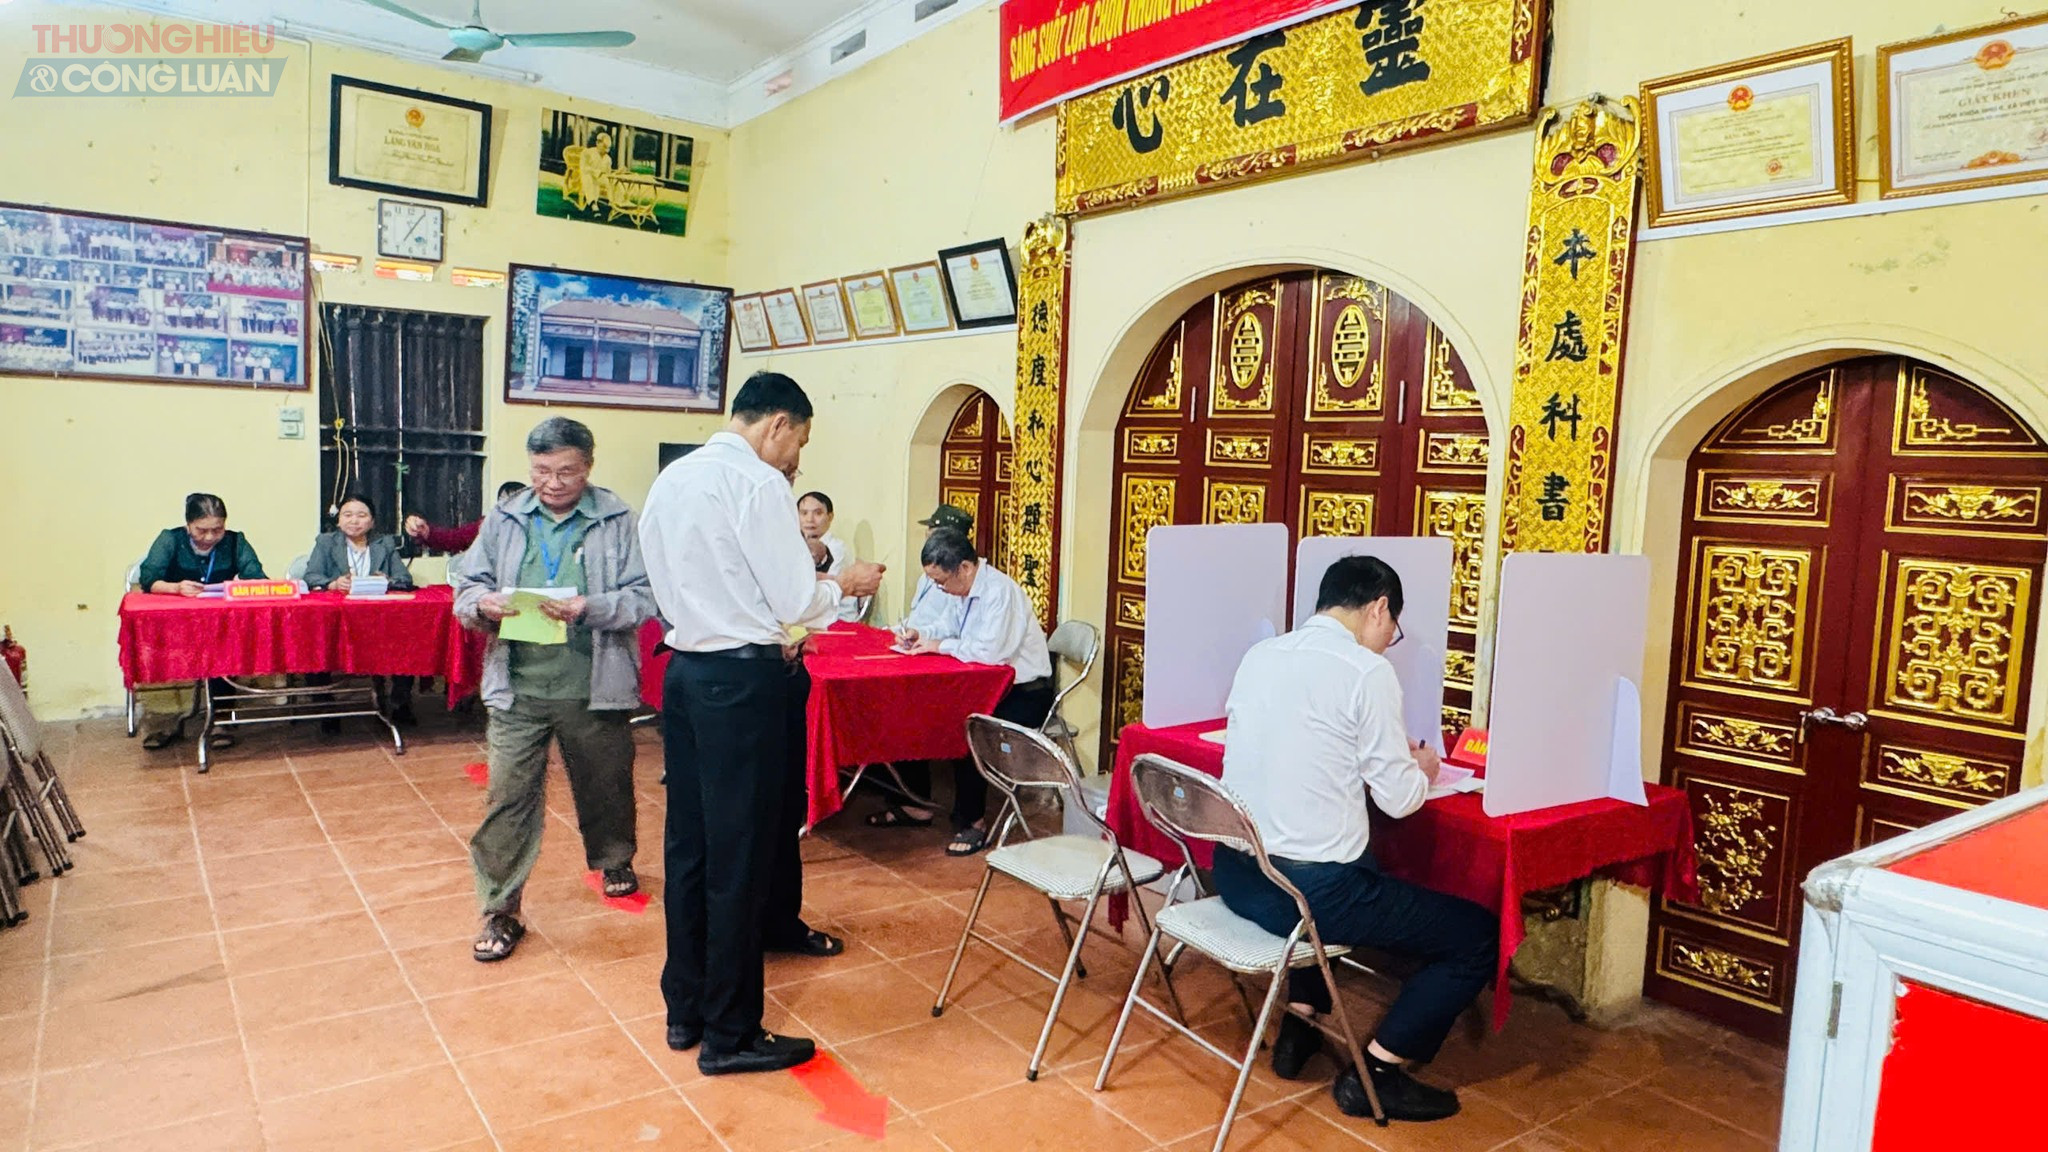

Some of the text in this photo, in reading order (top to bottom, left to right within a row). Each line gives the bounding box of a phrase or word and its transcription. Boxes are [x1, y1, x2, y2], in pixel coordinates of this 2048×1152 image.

[1010, 24, 1037, 82] SÁNG
[1037, 0, 1068, 69] SUỐT
[1065, 1, 1090, 64] LỰA
[1089, 0, 1123, 51] CHỌN
